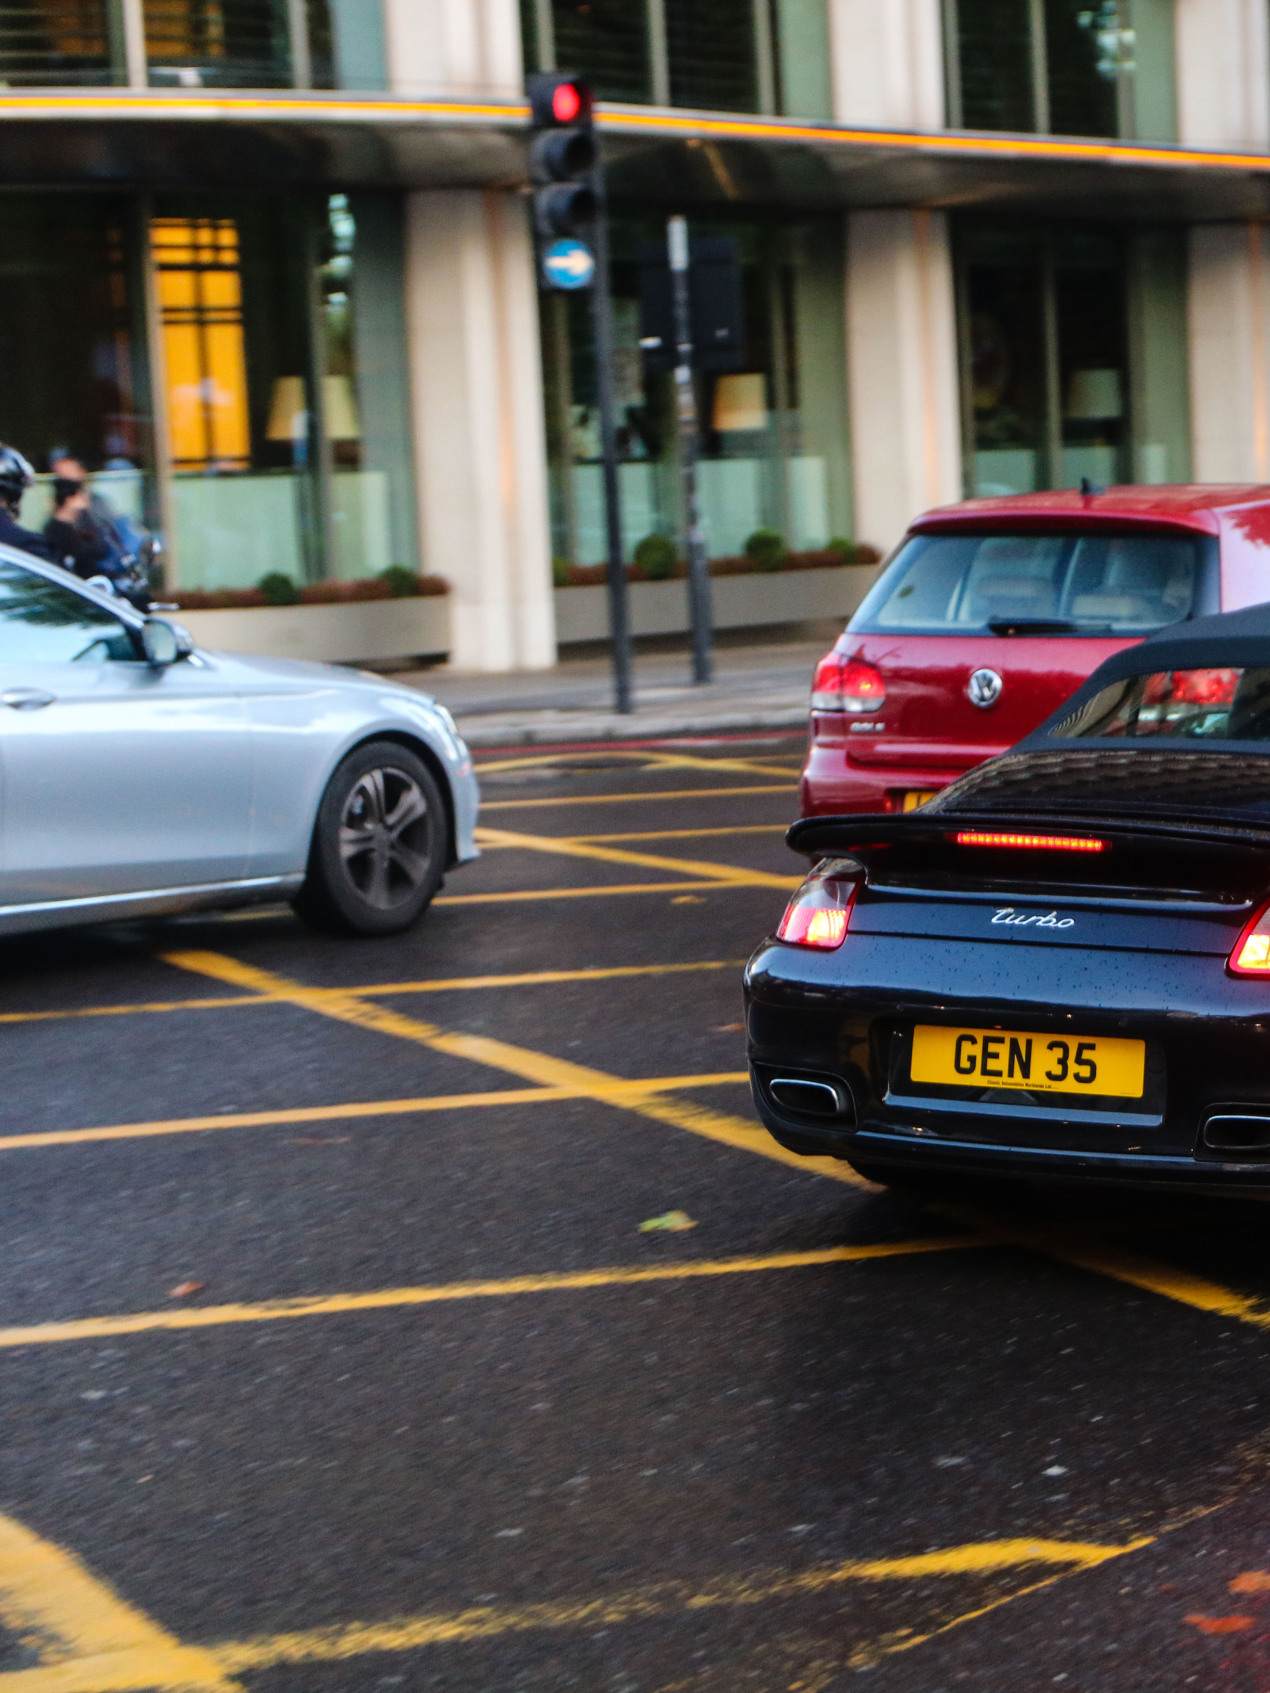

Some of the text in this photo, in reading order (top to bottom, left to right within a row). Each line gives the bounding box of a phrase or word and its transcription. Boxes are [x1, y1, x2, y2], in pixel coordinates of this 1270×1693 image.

[991, 907, 1075, 928] turbo
[954, 1033, 1097, 1084] GEN 35
